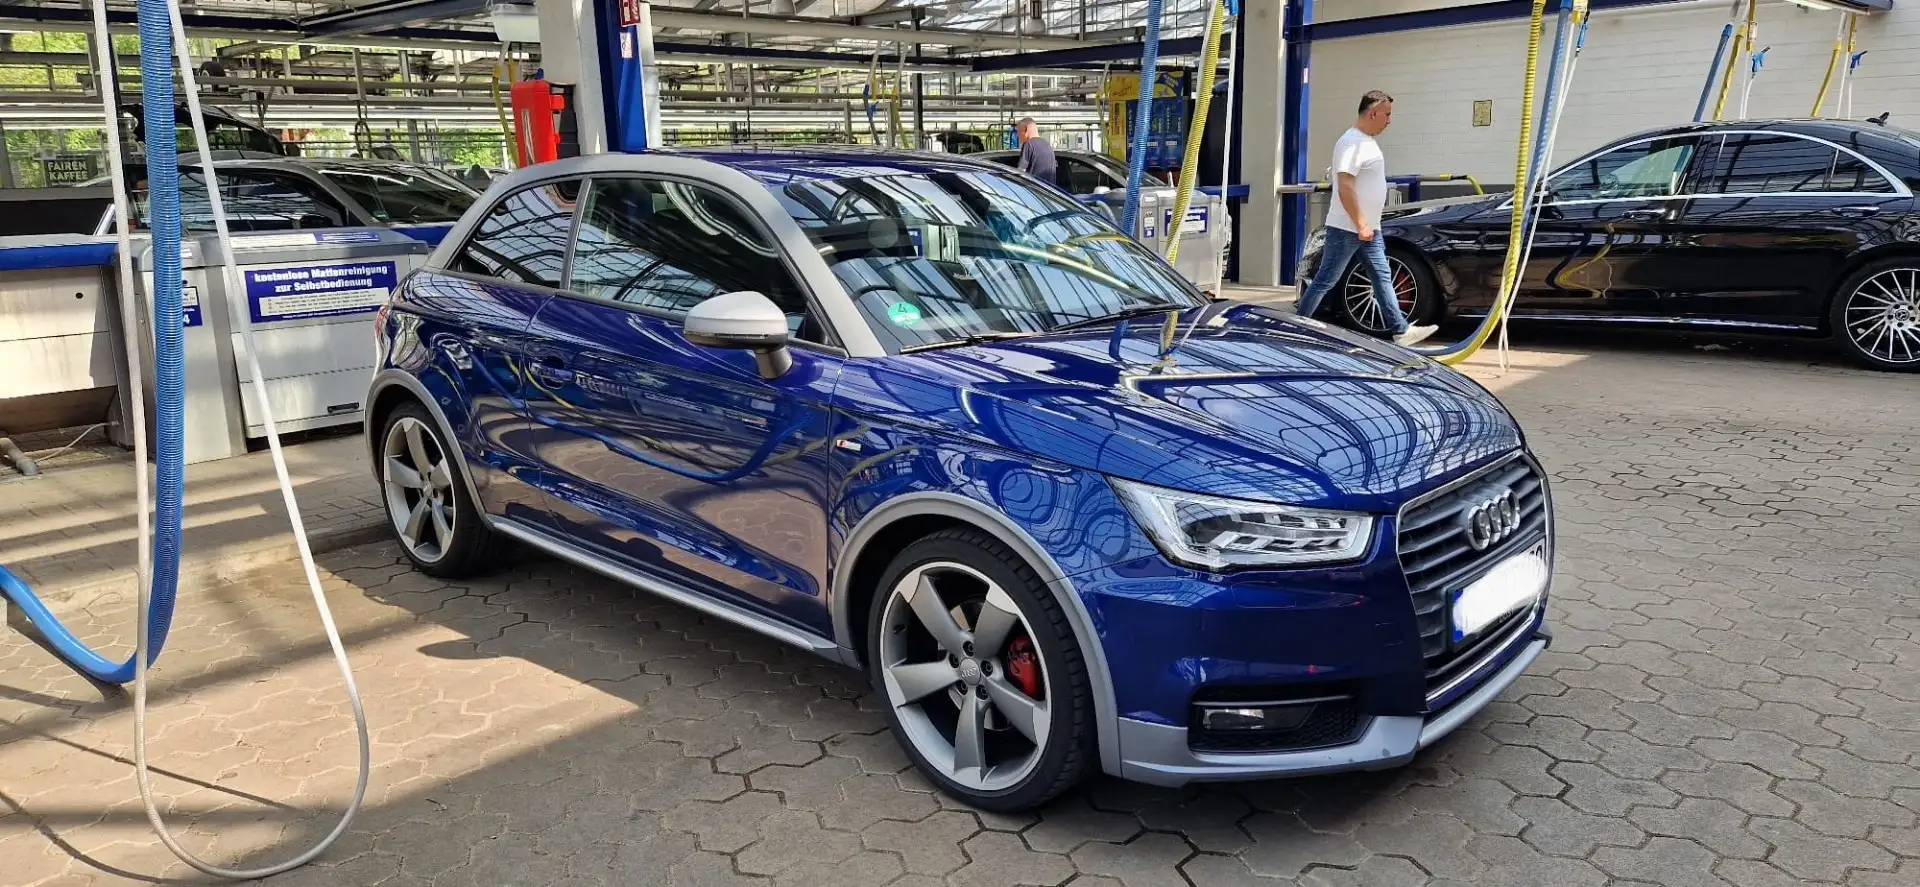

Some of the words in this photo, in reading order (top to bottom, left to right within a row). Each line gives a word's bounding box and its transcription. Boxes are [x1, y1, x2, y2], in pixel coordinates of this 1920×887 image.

[47, 161, 87, 171] FAIREN
[49, 170, 89, 180] KAFFEE
[254, 270, 309, 282] kostenlose
[311, 266, 388, 278] Mattenreinigung
[275, 283, 292, 292] zur
[294, 278, 373, 292] Selbstbedienung
[898, 303, 908, 314] 4
